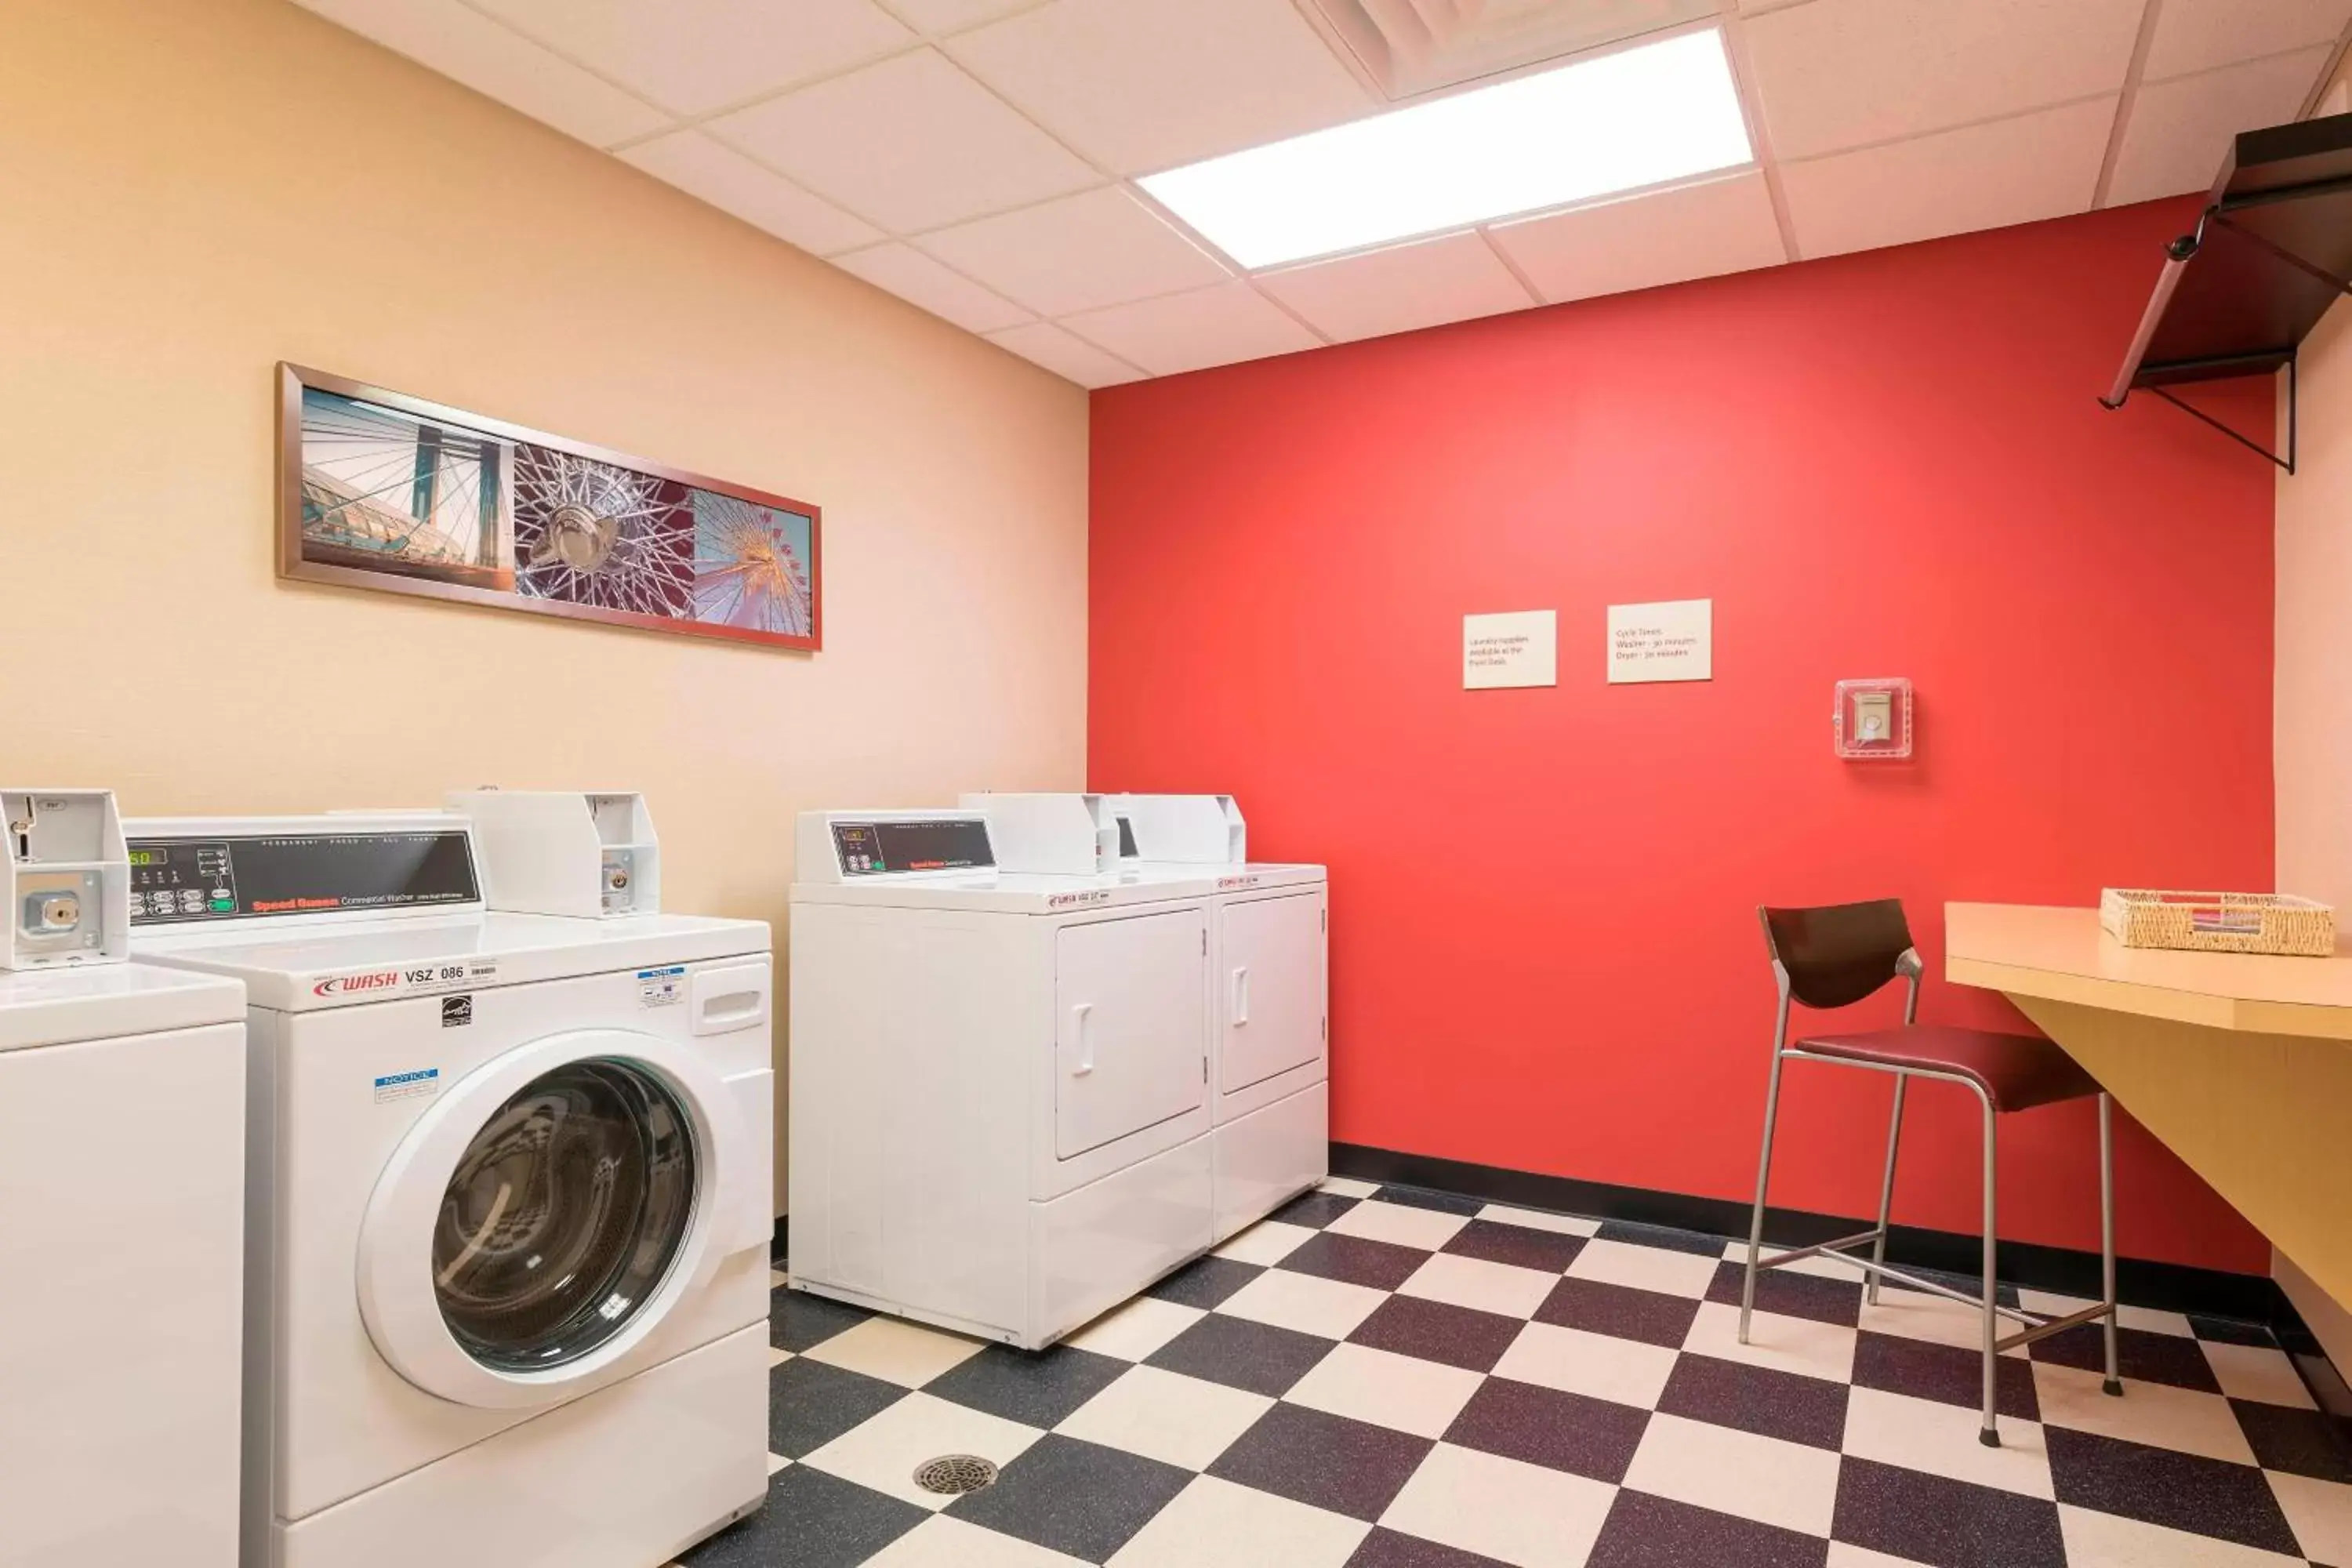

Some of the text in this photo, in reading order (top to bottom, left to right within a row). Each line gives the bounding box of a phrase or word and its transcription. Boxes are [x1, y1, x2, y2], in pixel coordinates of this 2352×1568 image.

[1616, 640, 1646, 648] Washer
[1616, 651, 1639, 660] Dryer
[252, 899, 296, 912] Speed
[297, 898, 339, 909] Queen
[341, 895, 385, 906] Commercial
[387, 892, 413, 902] Washer
[343, 972, 397, 991] WASH
[405, 968, 434, 983] VSZ
[441, 966, 464, 979] 086
